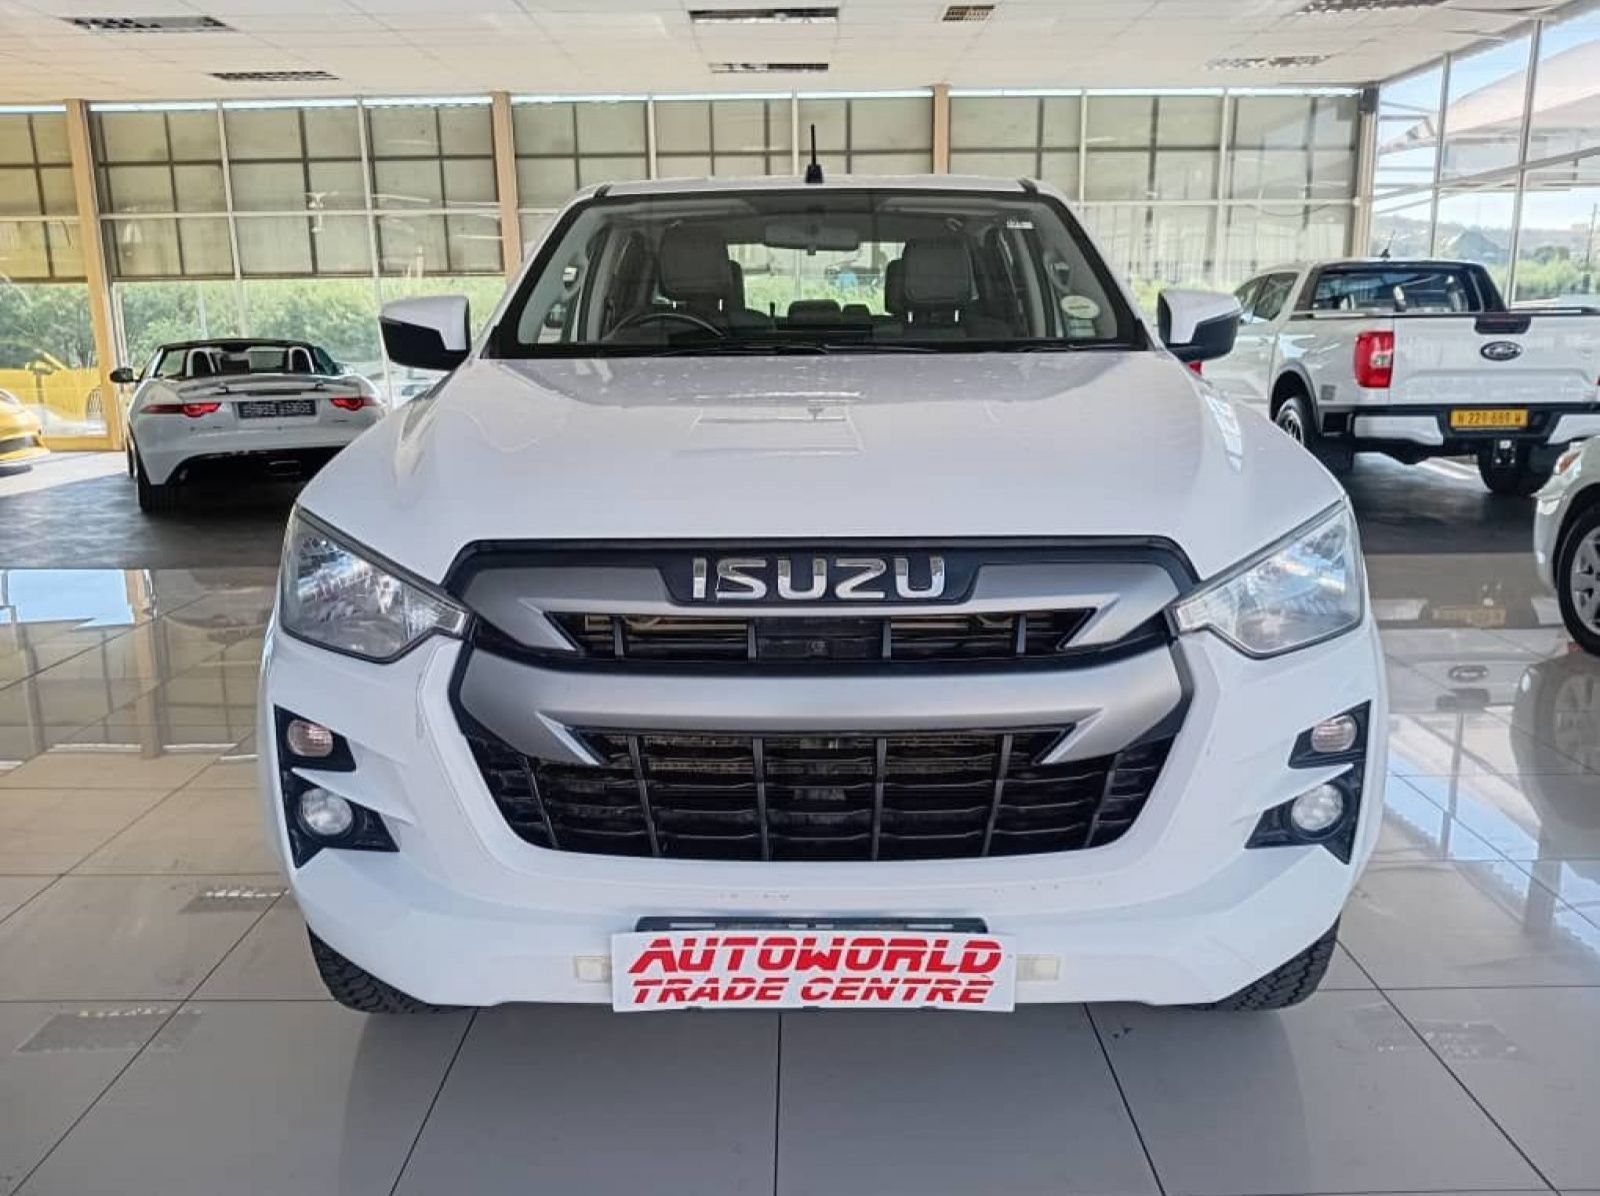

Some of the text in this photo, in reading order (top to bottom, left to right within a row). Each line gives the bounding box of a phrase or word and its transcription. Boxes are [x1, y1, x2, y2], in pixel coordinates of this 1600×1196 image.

[692, 556, 945, 599] ISUZU
[628, 936, 1001, 974] AUTOWORLD
[633, 977, 994, 1003] TRADE CENTRE
